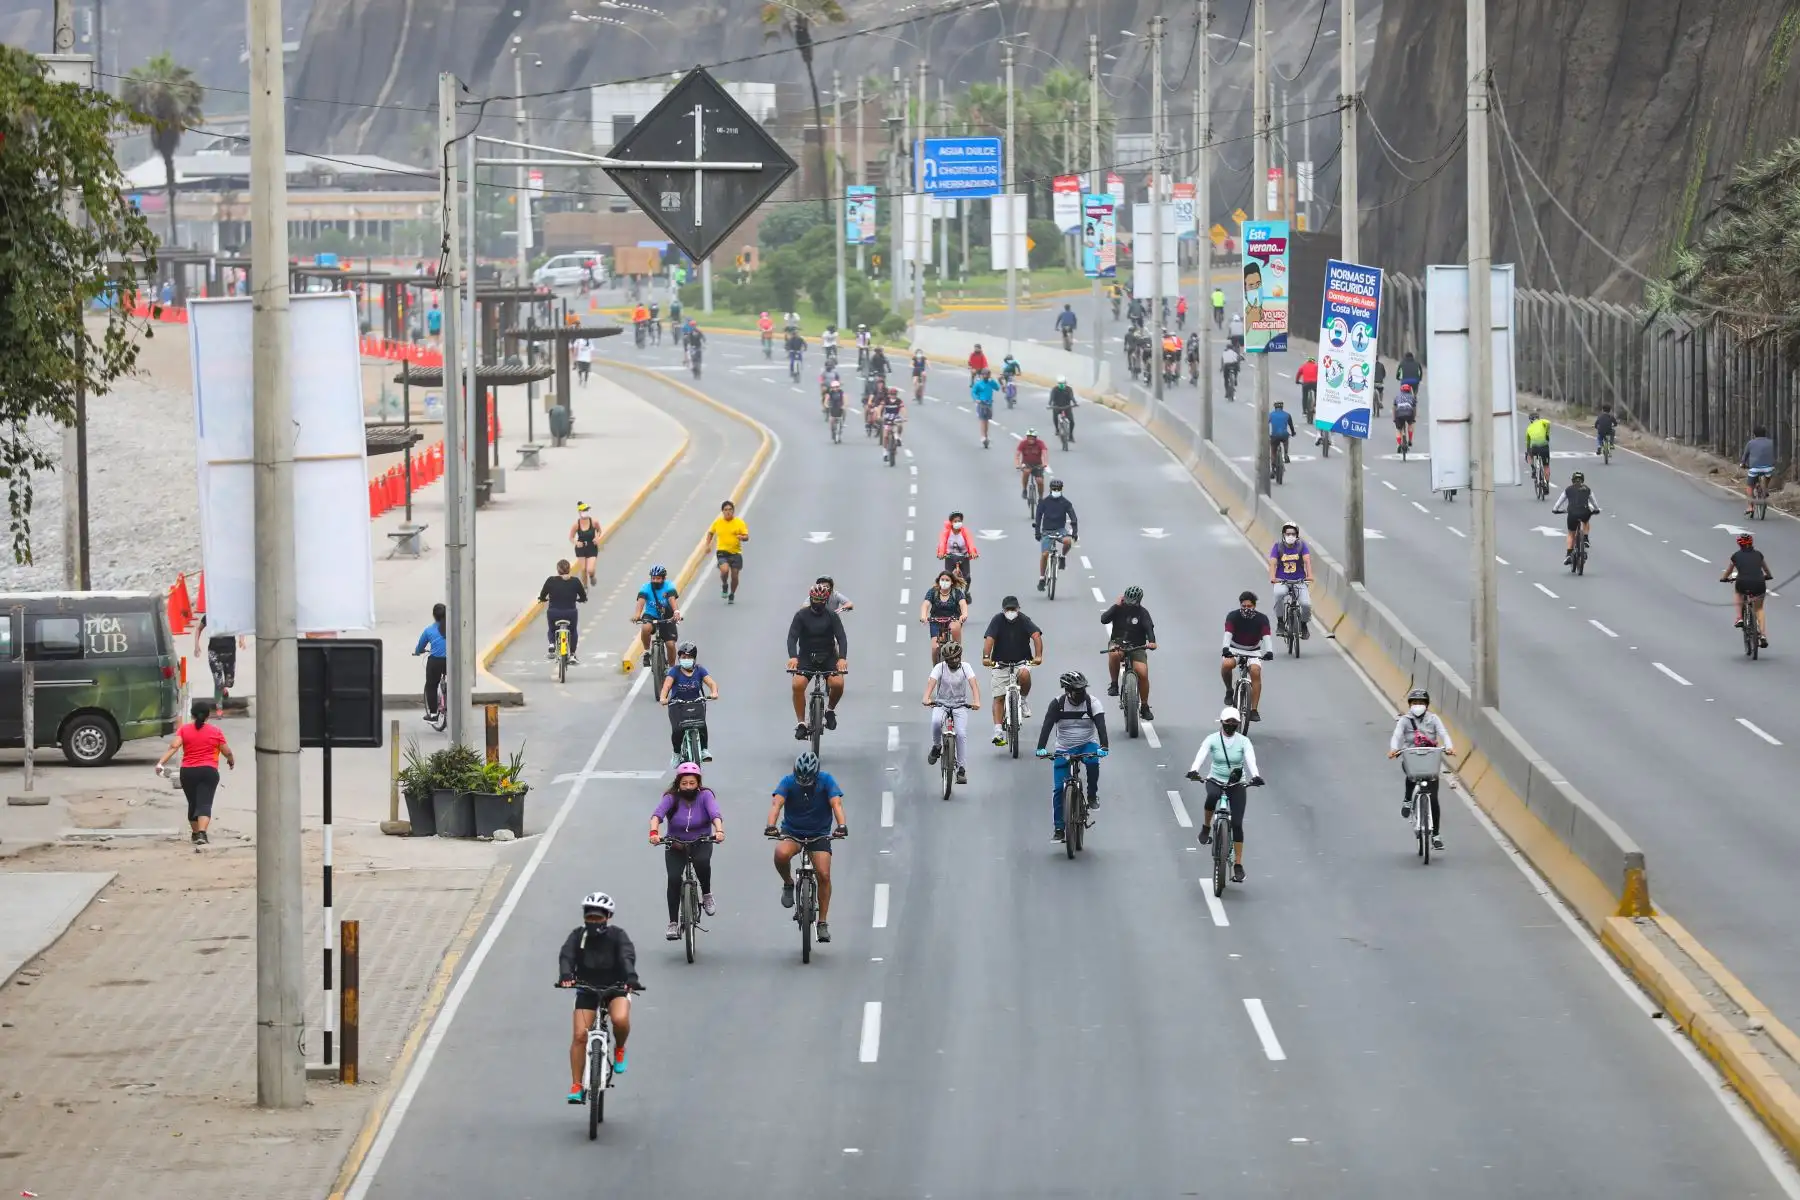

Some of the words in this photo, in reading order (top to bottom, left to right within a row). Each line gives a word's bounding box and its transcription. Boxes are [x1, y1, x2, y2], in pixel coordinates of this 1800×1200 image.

[938, 146, 964, 156] AGUA
[966, 146, 996, 156] DULCE
[938, 166, 997, 174] CHORRILLOS
[924, 180, 937, 189] LA
[939, 179, 996, 188] HERRADURA
[1249, 229, 1266, 240] Este
[1250, 244, 1284, 252] verano...
[1330, 268, 1364, 284] NORMAS
[1366, 274, 1376, 286] DE
[1330, 280, 1374, 296] SEGURIDAD
[1328, 292, 1352, 304] Domingo
[1361, 298, 1376, 307] Autos
[1263, 311, 1272, 320] yo
[1273, 310, 1286, 318] uso
[1331, 302, 1350, 315] Costa
[1352, 306, 1370, 318] Verde
[1252, 320, 1286, 329] mascarilla
[1351, 424, 1367, 434] LIMA
